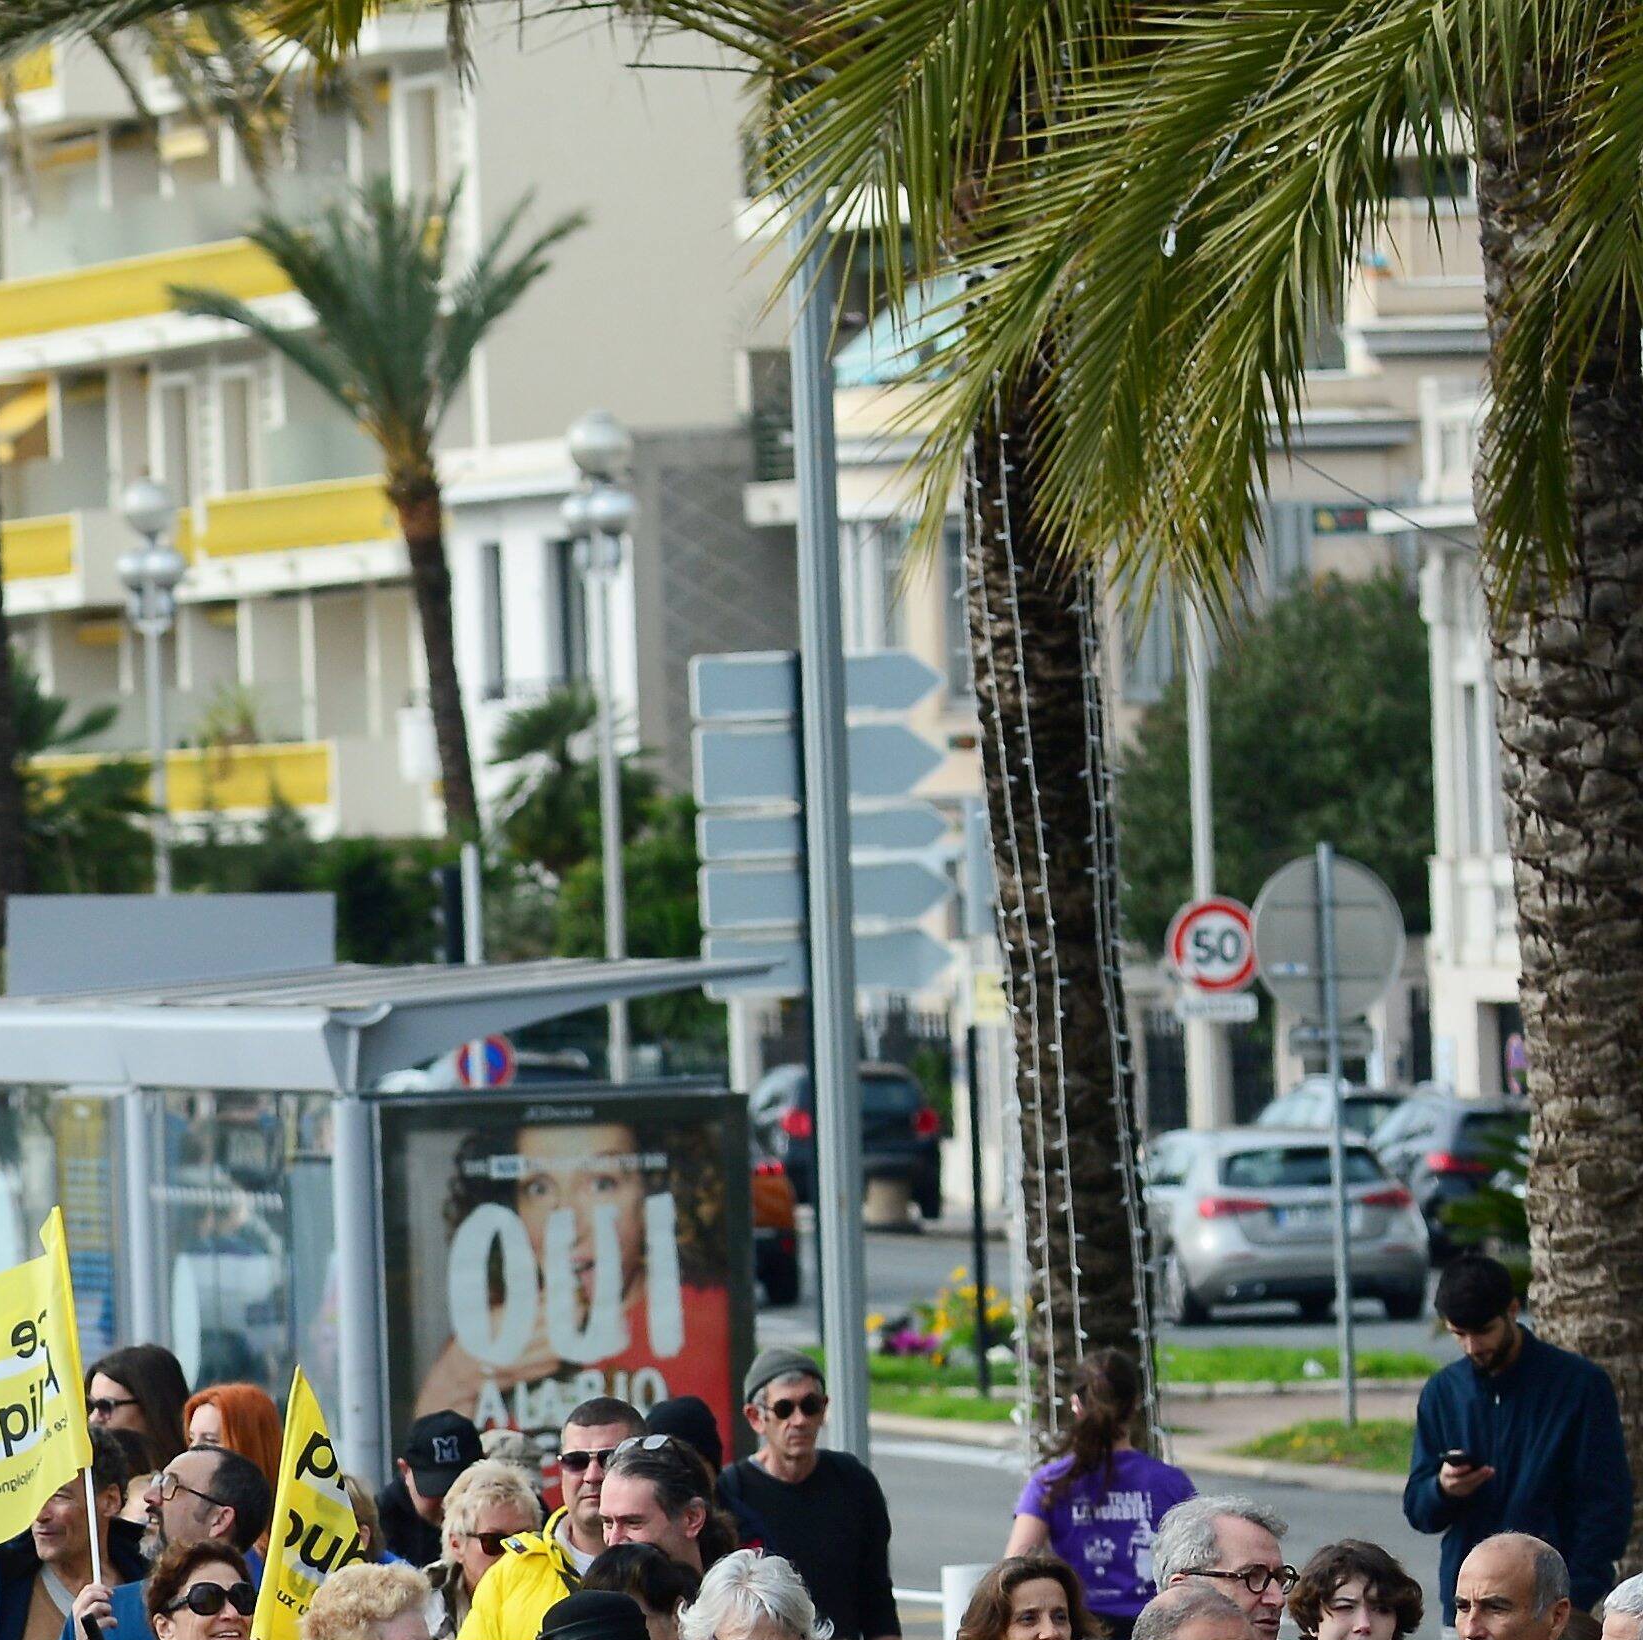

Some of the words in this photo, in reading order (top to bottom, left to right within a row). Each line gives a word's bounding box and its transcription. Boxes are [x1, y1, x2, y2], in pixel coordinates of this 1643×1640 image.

[1193, 929, 1241, 963] 50
[447, 1192, 686, 1367] OUI
[432, 1436, 462, 1464] M
